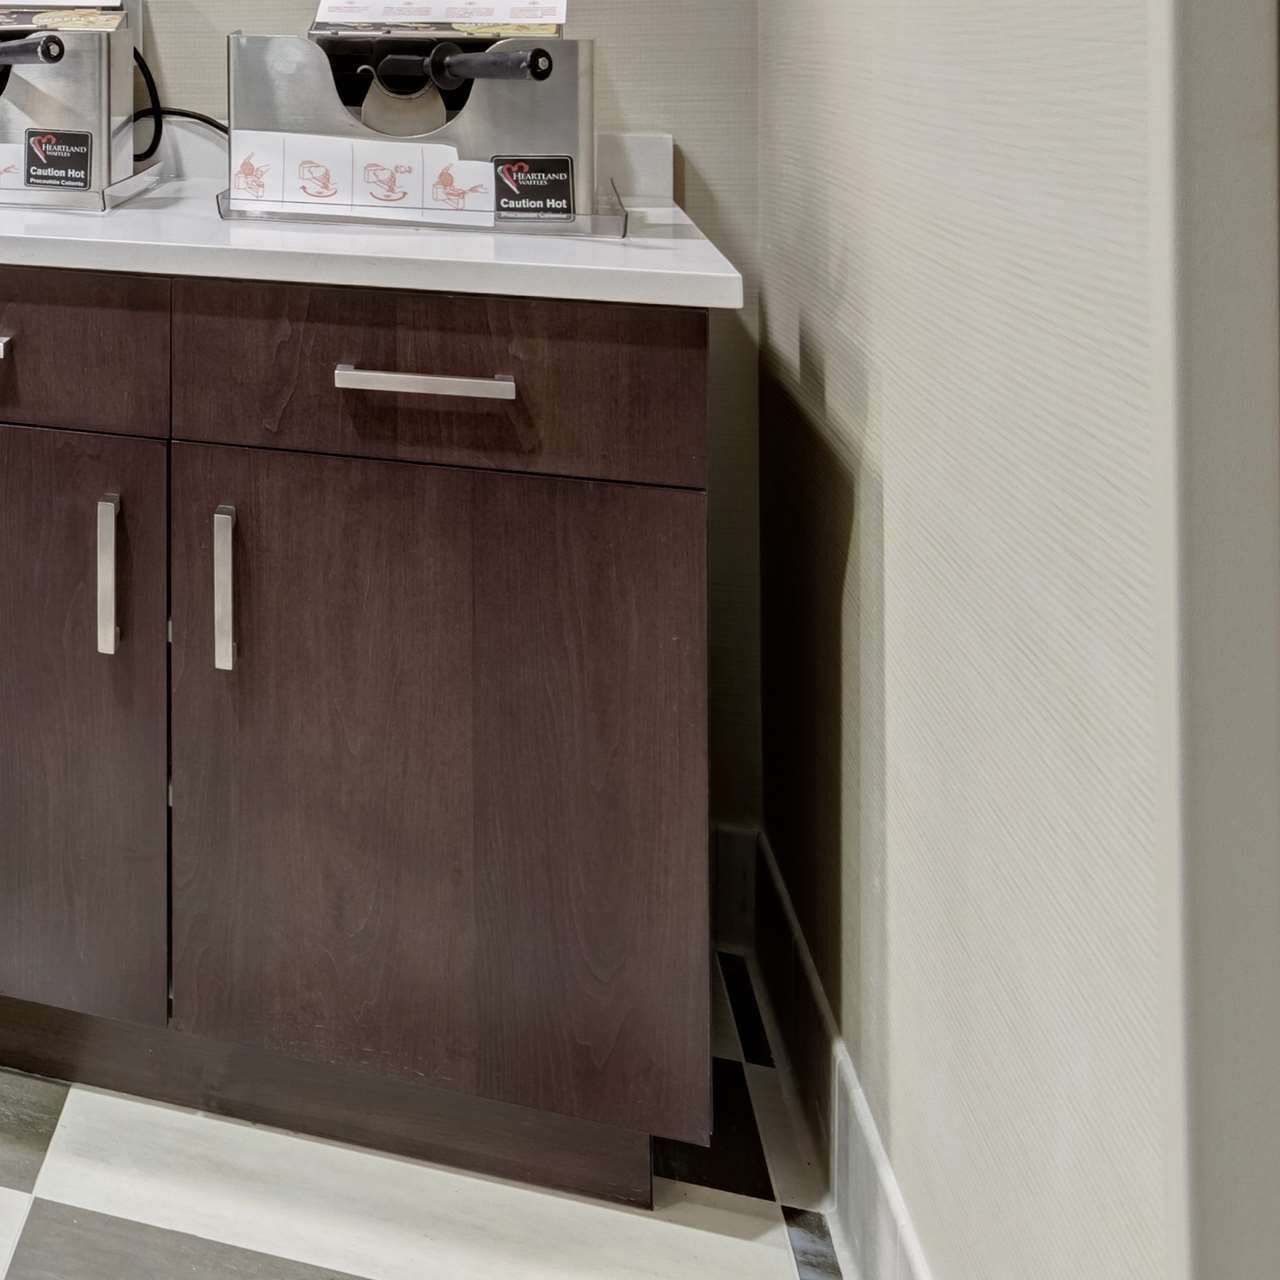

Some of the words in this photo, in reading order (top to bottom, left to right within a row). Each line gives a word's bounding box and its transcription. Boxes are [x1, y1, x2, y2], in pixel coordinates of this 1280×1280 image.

[42, 143, 87, 153] HEARTLAND
[30, 166, 66, 177] Caution
[67, 168, 86, 179] Hot
[513, 172, 568, 181] HEARTLAND
[500, 198, 543, 209] Caution
[546, 198, 568, 209] Hot
